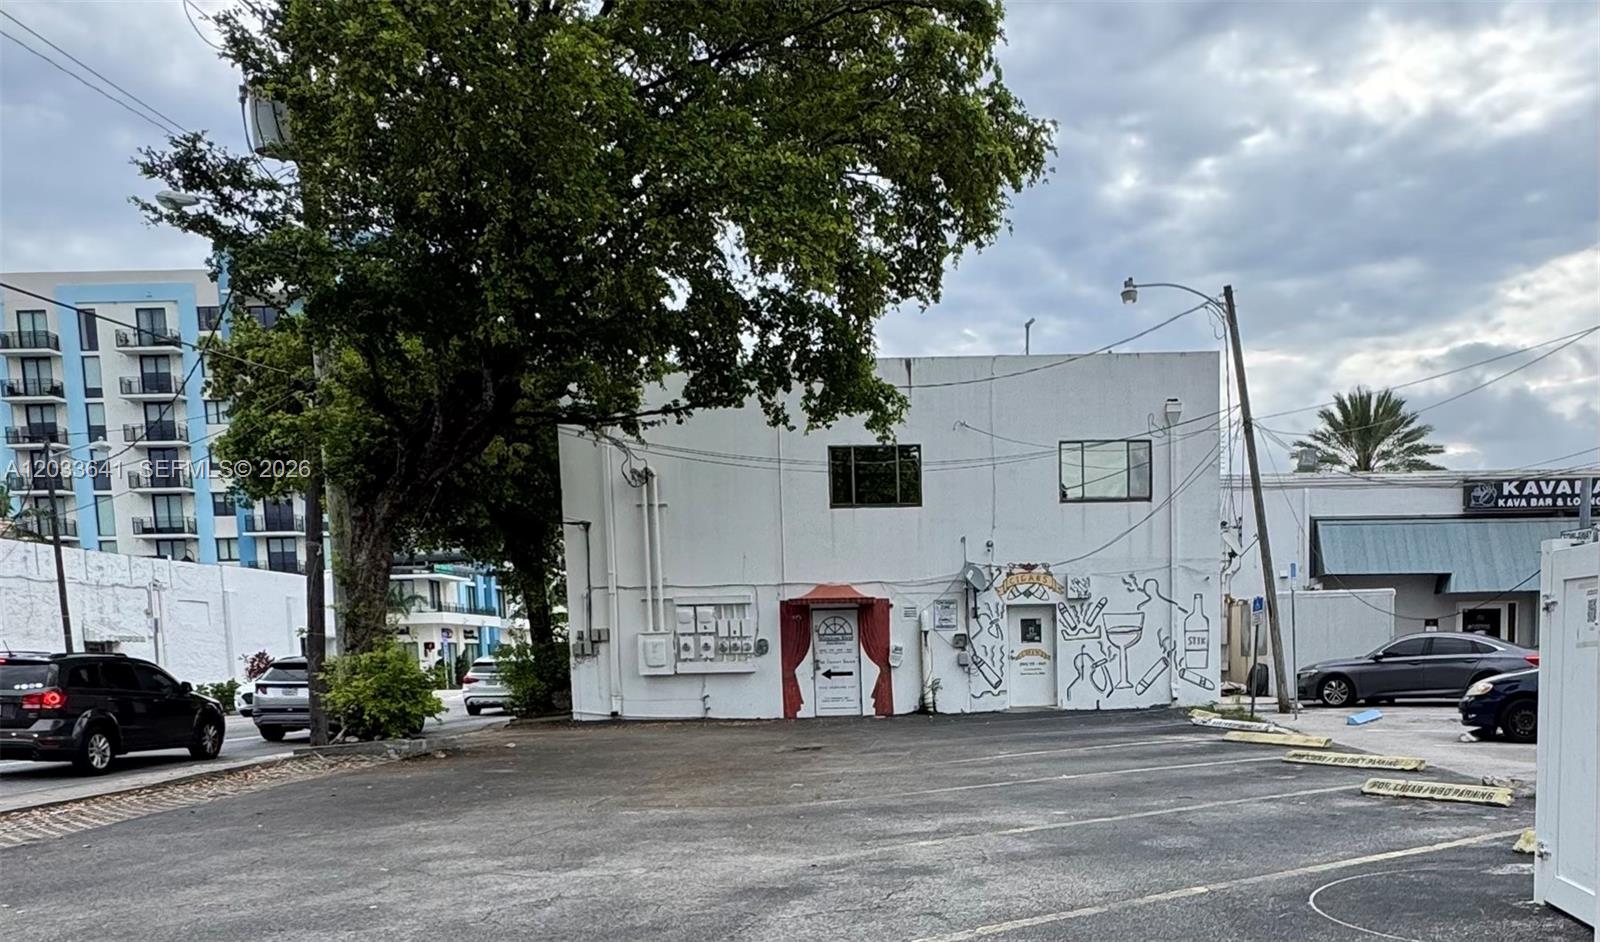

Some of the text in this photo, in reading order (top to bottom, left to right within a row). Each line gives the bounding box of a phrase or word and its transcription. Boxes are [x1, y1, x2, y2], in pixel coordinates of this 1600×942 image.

[1497, 498, 1528, 508] KAVA
[1530, 497, 1554, 507] BAR
[1556, 497, 1565, 506] &
[1009, 575, 1048, 584] CIGARS
